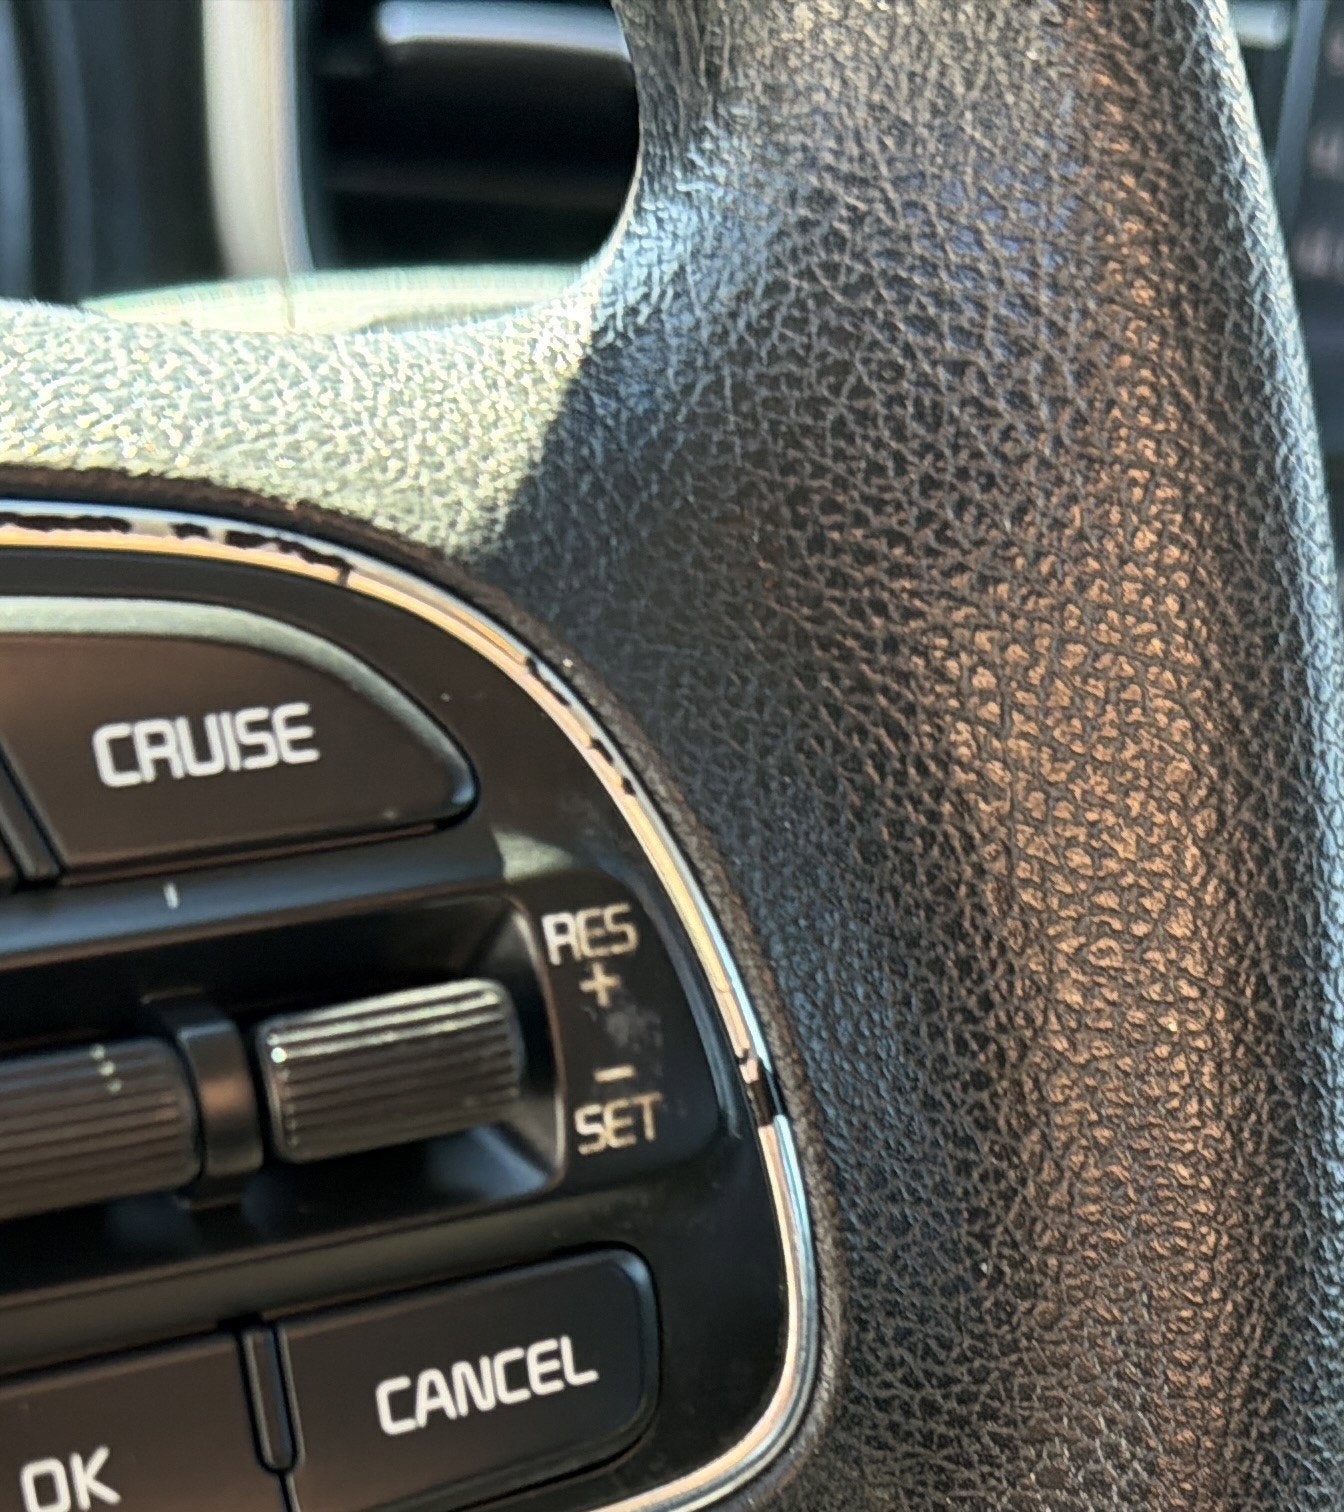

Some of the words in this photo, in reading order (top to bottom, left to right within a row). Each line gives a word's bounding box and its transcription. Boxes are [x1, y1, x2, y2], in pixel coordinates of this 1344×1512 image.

[92, 702, 320, 788] CRUISE
[542, 903, 640, 965] RES
[574, 1092, 664, 1155] SET
[375, 1335, 599, 1435] CANCEL
